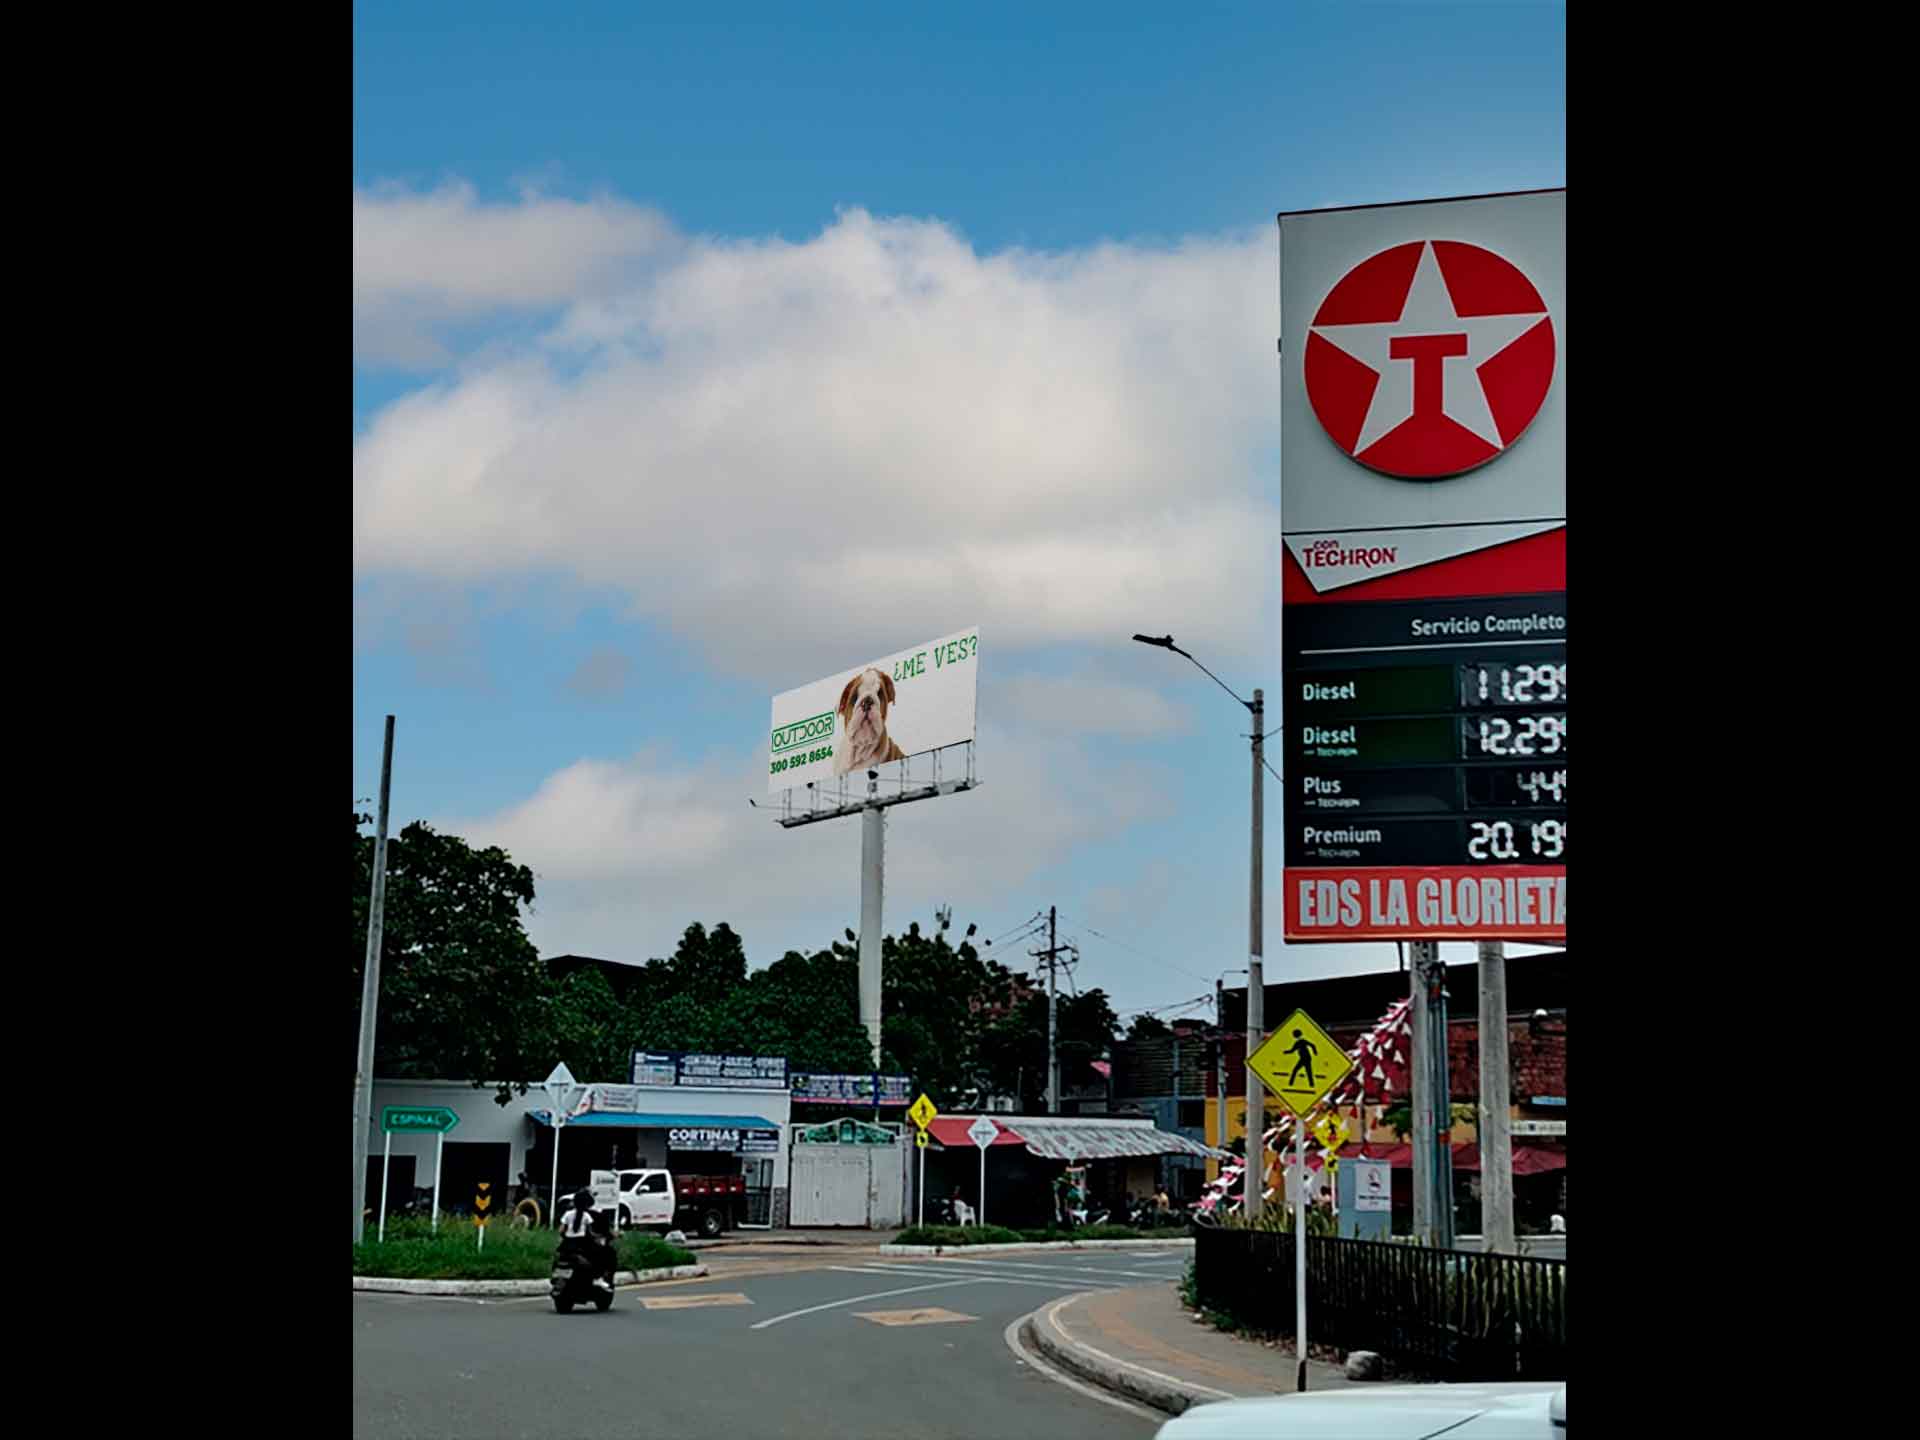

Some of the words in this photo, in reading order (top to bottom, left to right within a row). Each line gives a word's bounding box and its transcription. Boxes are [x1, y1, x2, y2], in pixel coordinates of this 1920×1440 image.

[1313, 539, 1339, 550] con
[1302, 547, 1397, 569] TECHRON
[1411, 616, 1481, 637] Servicio
[1484, 613, 1566, 635] Completo
[892, 651, 927, 682] ¿ME
[934, 635, 978, 669] VES?
[1303, 681, 1356, 700] Diesel
[773, 716, 833, 748] OUTDOOR
[1303, 726, 1356, 744] Diesel
[1480, 717, 1566, 755] 12.29
[770, 758, 787, 774] 300
[789, 754, 807, 769] 592
[809, 746, 833, 764] 8654
[1303, 776, 1342, 794] Plus
[1303, 825, 1382, 844] Premium
[1468, 820, 1566, 859] 20.19
[1300, 879, 1361, 927] EDS
[1370, 879, 1410, 927] LA
[669, 1128, 739, 1141] CORTINAS
